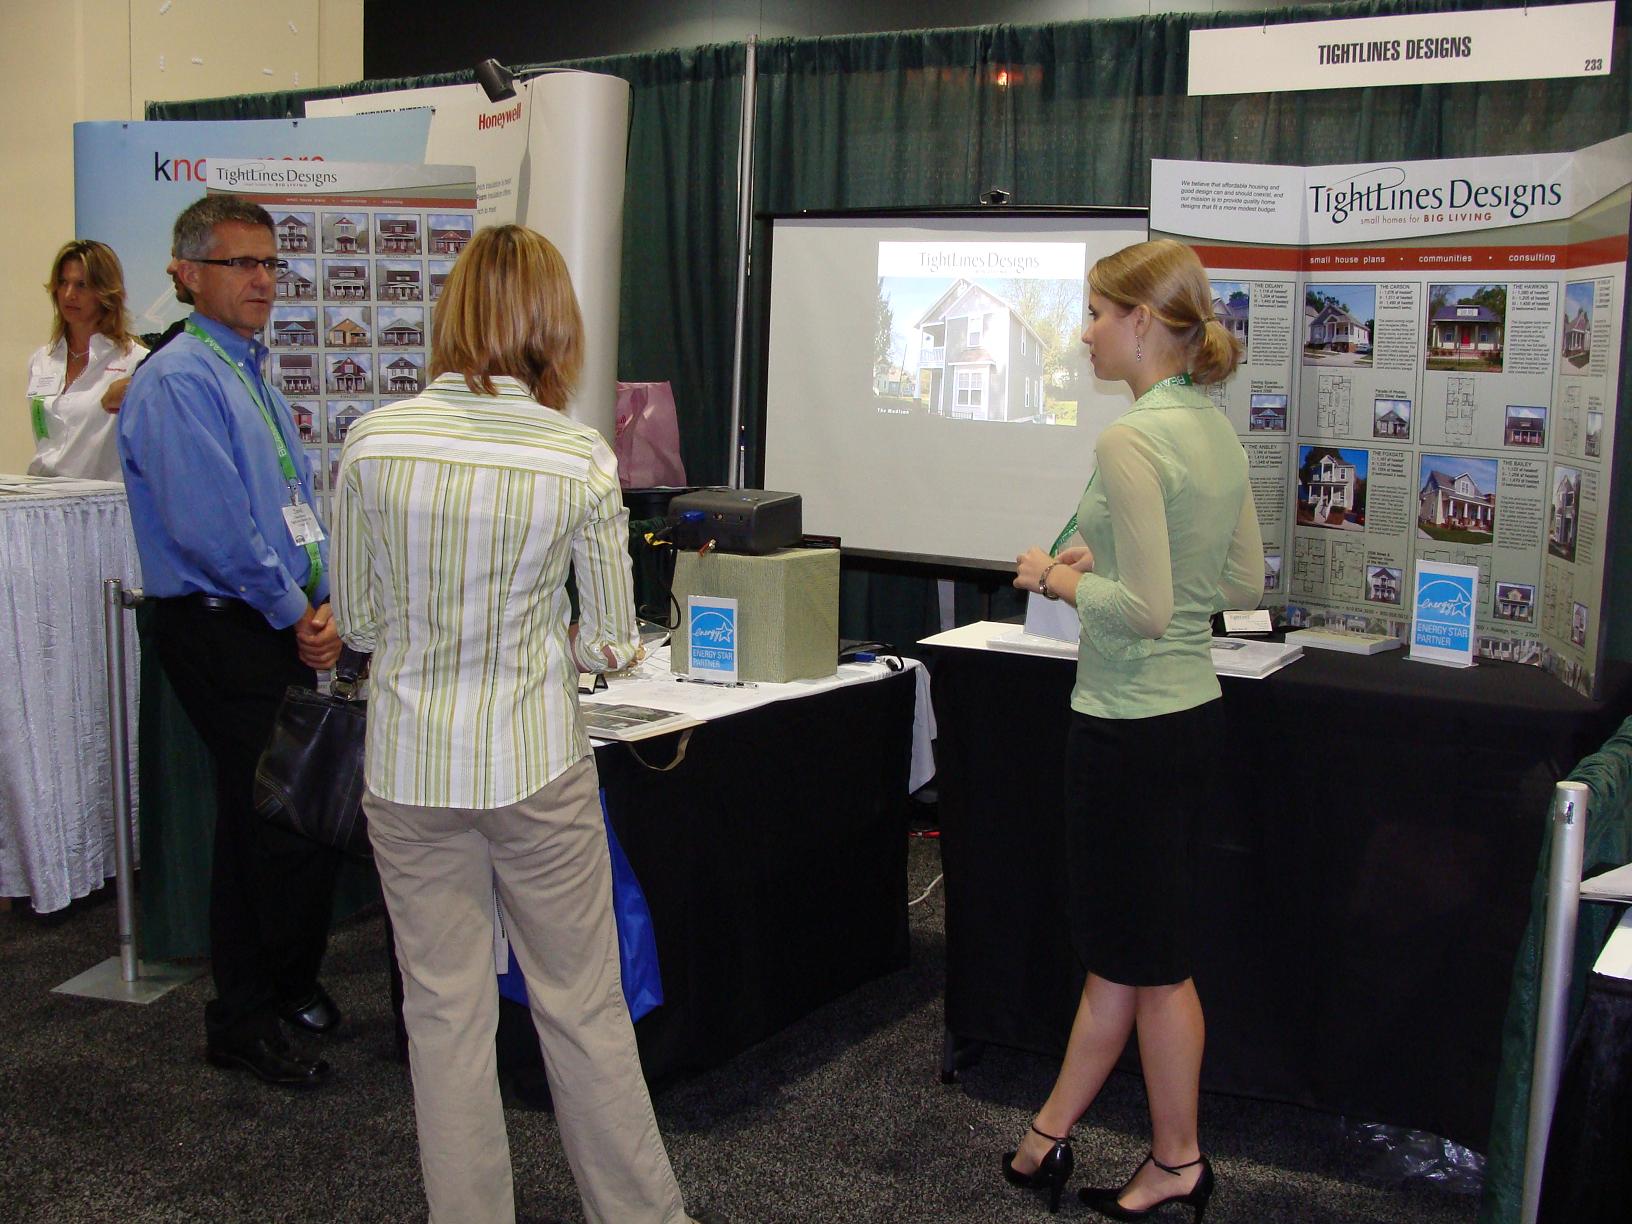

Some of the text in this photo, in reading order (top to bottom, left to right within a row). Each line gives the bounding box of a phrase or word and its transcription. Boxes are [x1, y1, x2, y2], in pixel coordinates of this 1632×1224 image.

[1318, 36, 1472, 65] TIGHTLINES DESIGNS
[1584, 58, 1603, 72] 233
[478, 102, 521, 130] Honeywell
[216, 166, 337, 187] TightLines Designs
[1309, 178, 1563, 225] TightLines Designs
[1360, 211, 1493, 225] small homes for BIG LIVING
[919, 251, 1041, 274] TightLines Designs
[1310, 252, 1557, 266] small house plans communities consulting
[1417, 622, 1448, 635] ENERGY
[1448, 627, 1468, 638] STAR
[1416, 633, 1451, 647] PARTNER
[693, 649, 733, 660] ENERGY STAR
[693, 658, 720, 668] PARTNER
